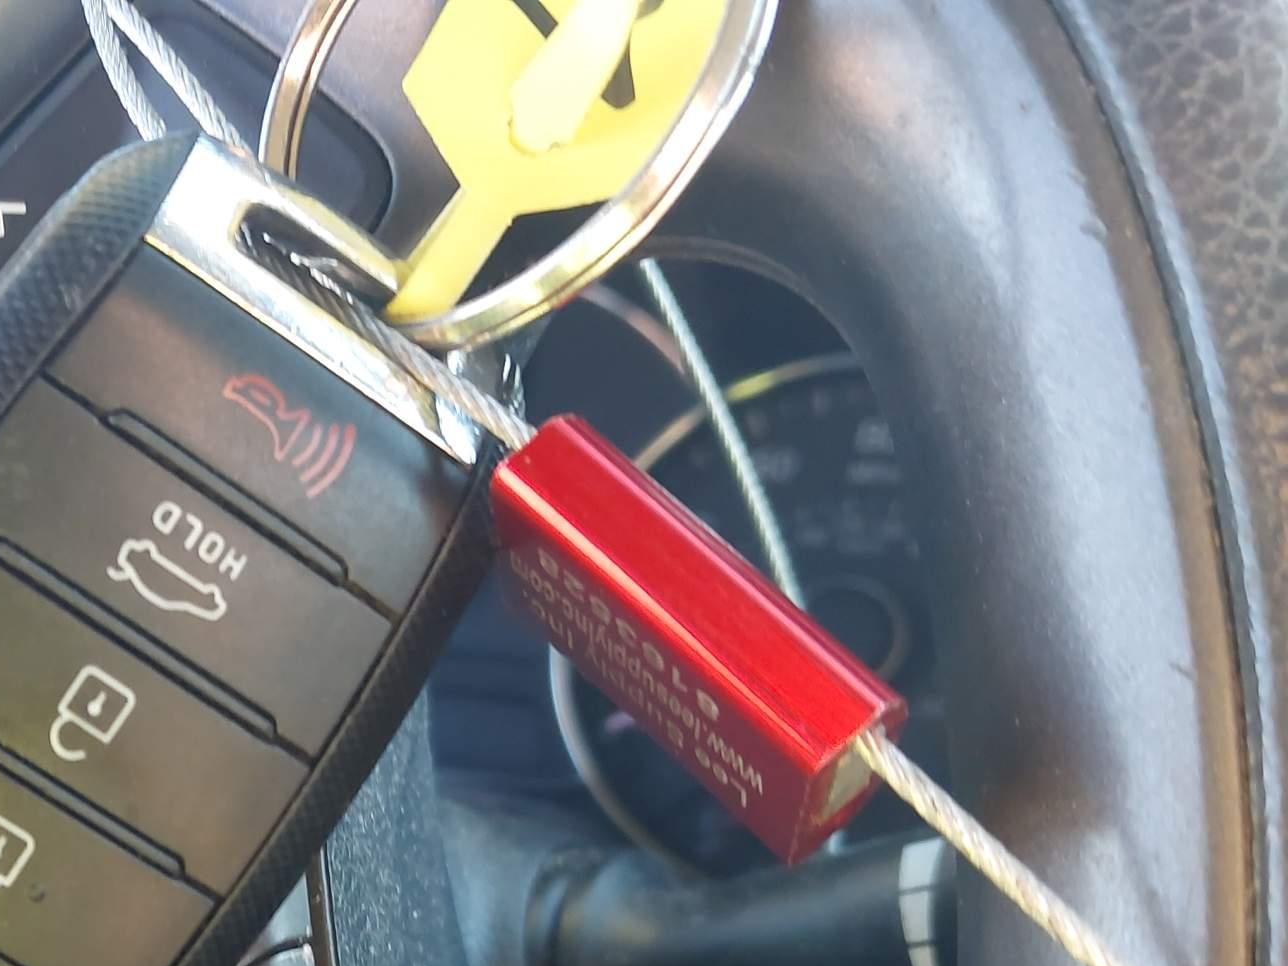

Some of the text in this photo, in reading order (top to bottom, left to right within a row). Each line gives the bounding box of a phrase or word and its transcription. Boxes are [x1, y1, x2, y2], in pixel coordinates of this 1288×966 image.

[152, 501, 248, 582] HOLD
[522, 589, 748, 809] Lee Supply Inc.
